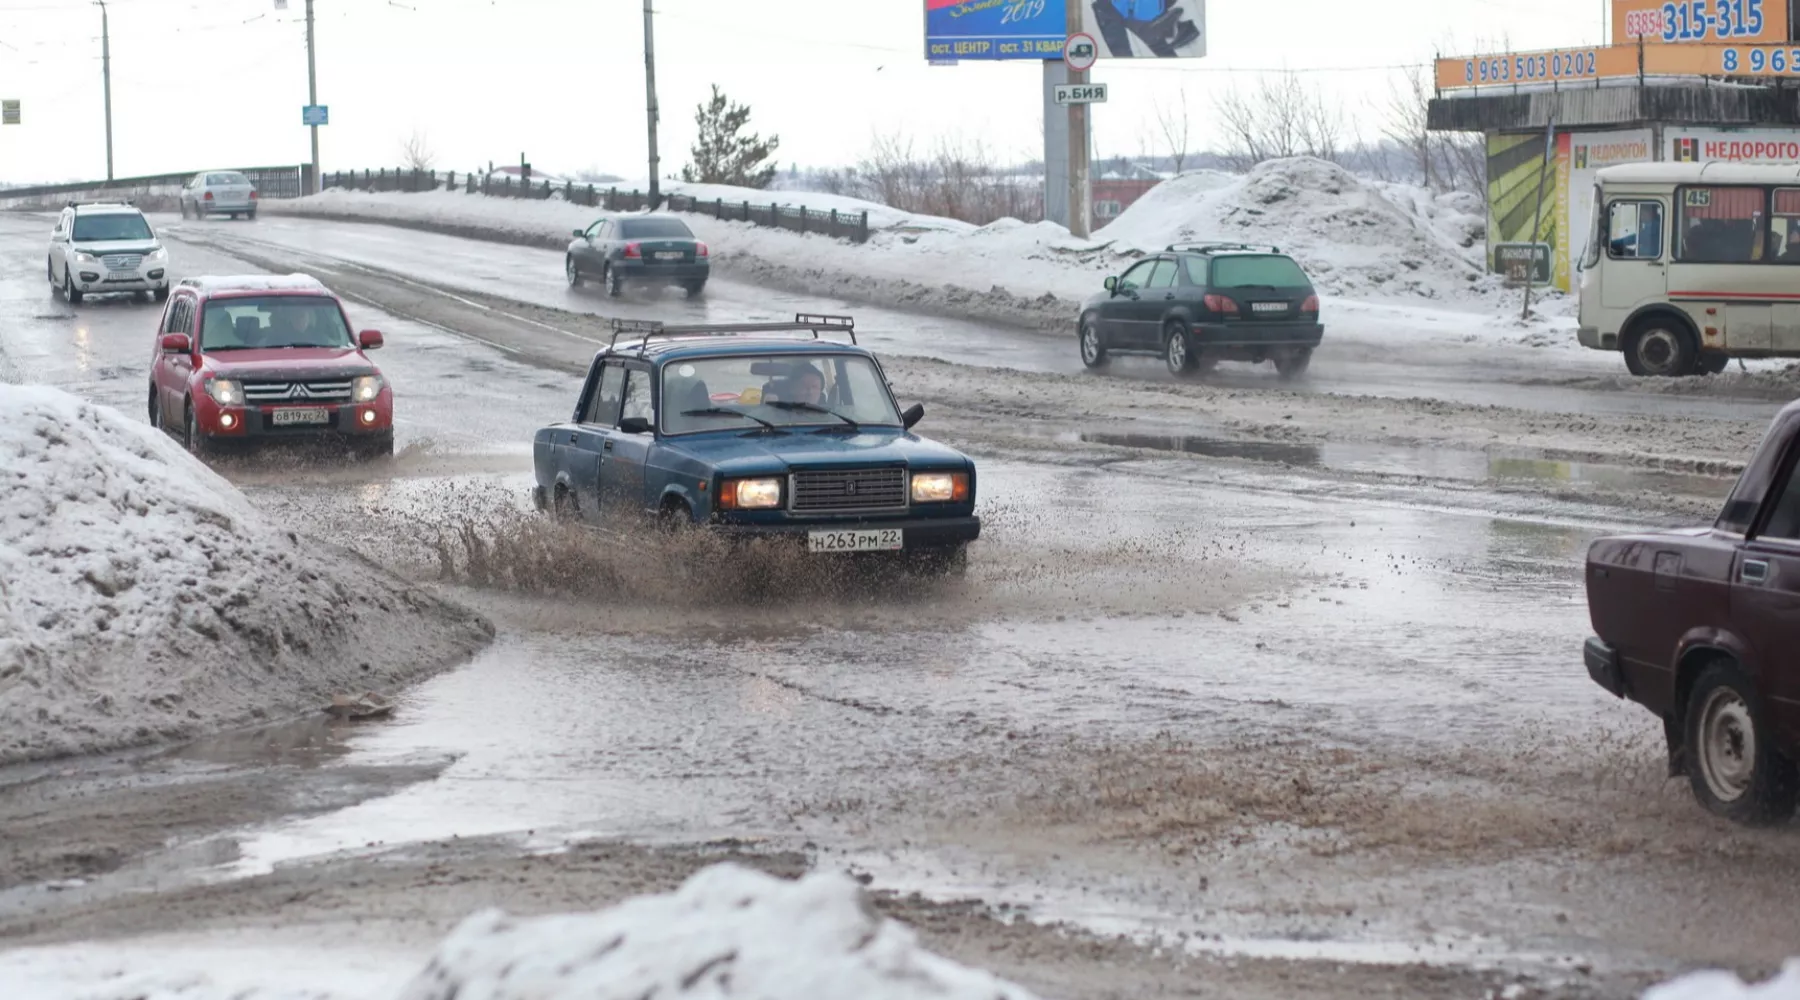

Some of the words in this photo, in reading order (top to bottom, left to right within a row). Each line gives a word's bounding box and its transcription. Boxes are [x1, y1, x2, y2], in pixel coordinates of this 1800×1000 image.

[1000, 0, 1045, 24] 2019
[1627, 11, 1663, 35] 83854
[1663, 0, 1763, 41] 315-315
[954, 41, 990, 55] ЦЕНТР
[1022, 40, 1033, 52] 31
[1466, 61, 1473, 82] 8
[1480, 60, 1509, 80] 963
[1516, 57, 1546, 78] 503
[1552, 52, 1595, 76] 0202
[1723, 49, 1738, 71] 8
[1687, 190, 1709, 205] 45
[1501, 248, 1544, 260] ЛИНОЛЕМ
[882, 530, 897, 543] 22
